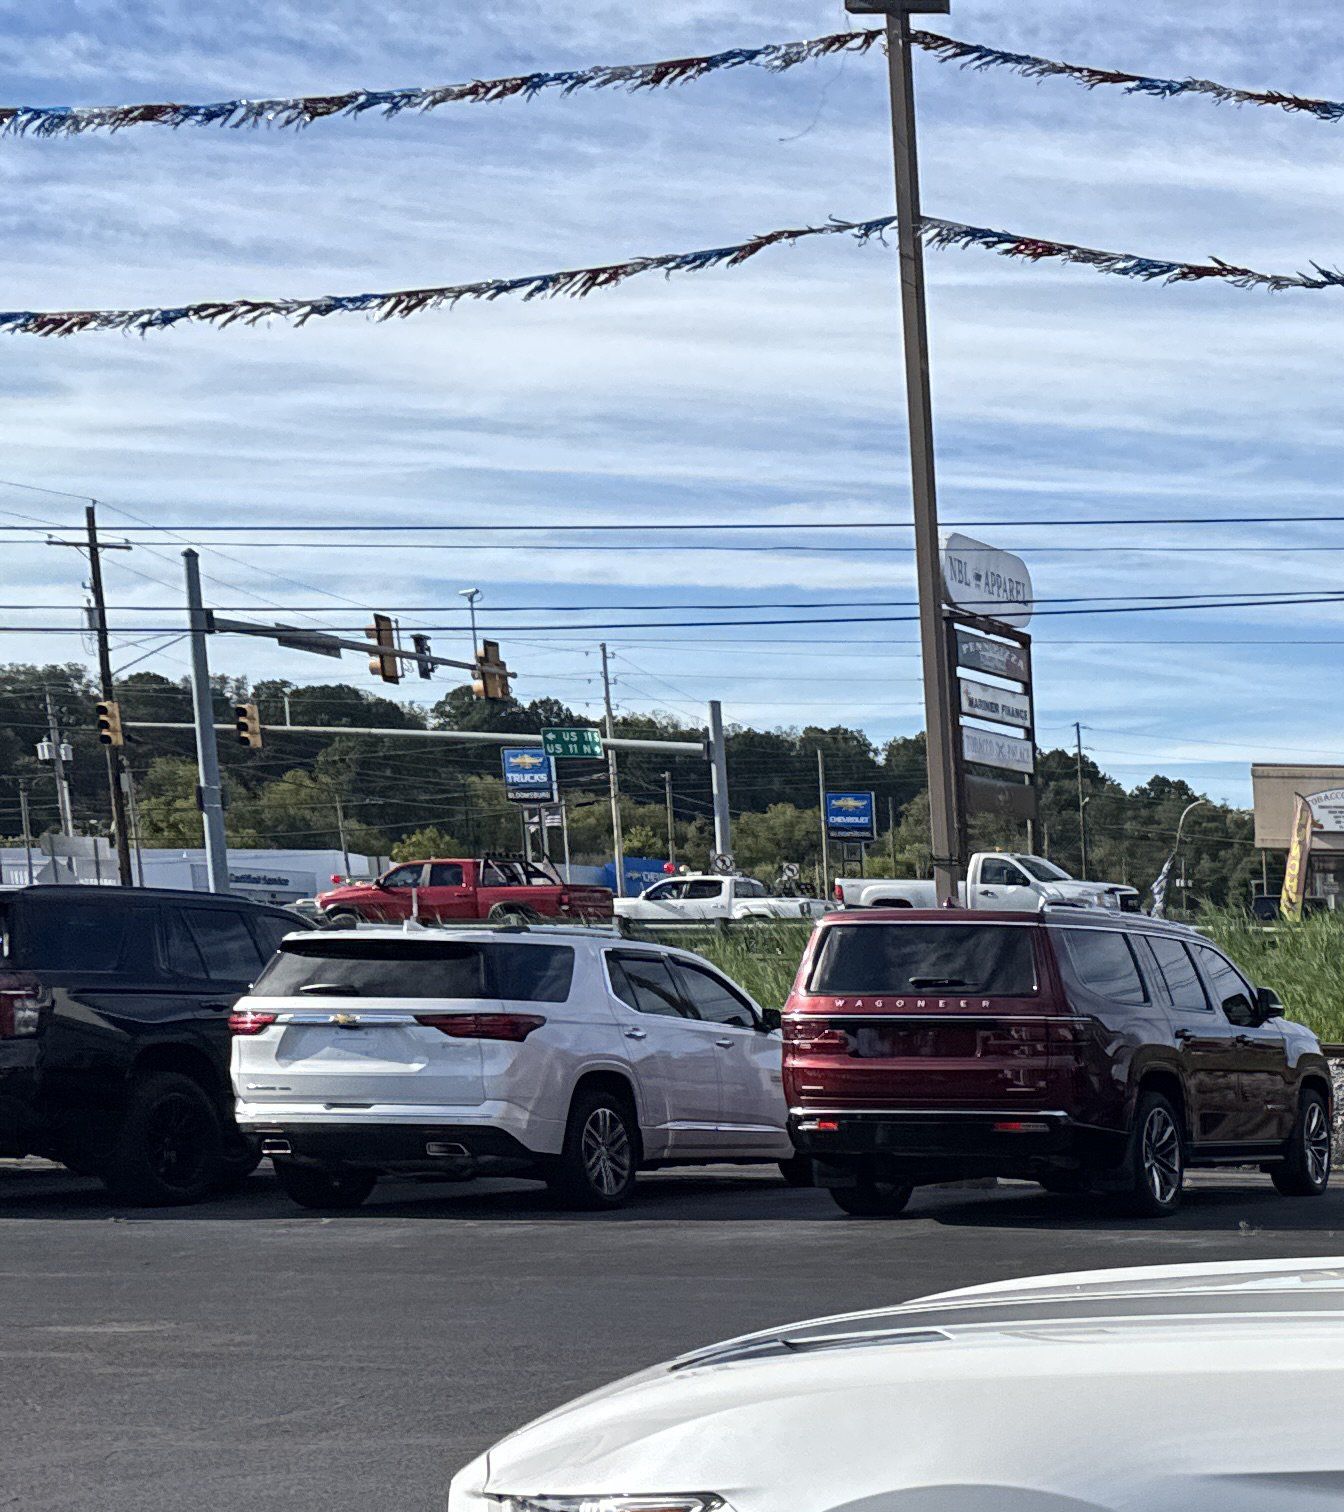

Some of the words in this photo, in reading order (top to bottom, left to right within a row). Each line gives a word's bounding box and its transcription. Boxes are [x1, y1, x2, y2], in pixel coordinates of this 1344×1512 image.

[984, 570, 1029, 607] APPAREL
[562, 731, 578, 741] US
[546, 744, 563, 754] US
[583, 745, 592, 754] N
[506, 773, 548, 783] TRUCKS
[834, 999, 990, 1008] WAGONEER
